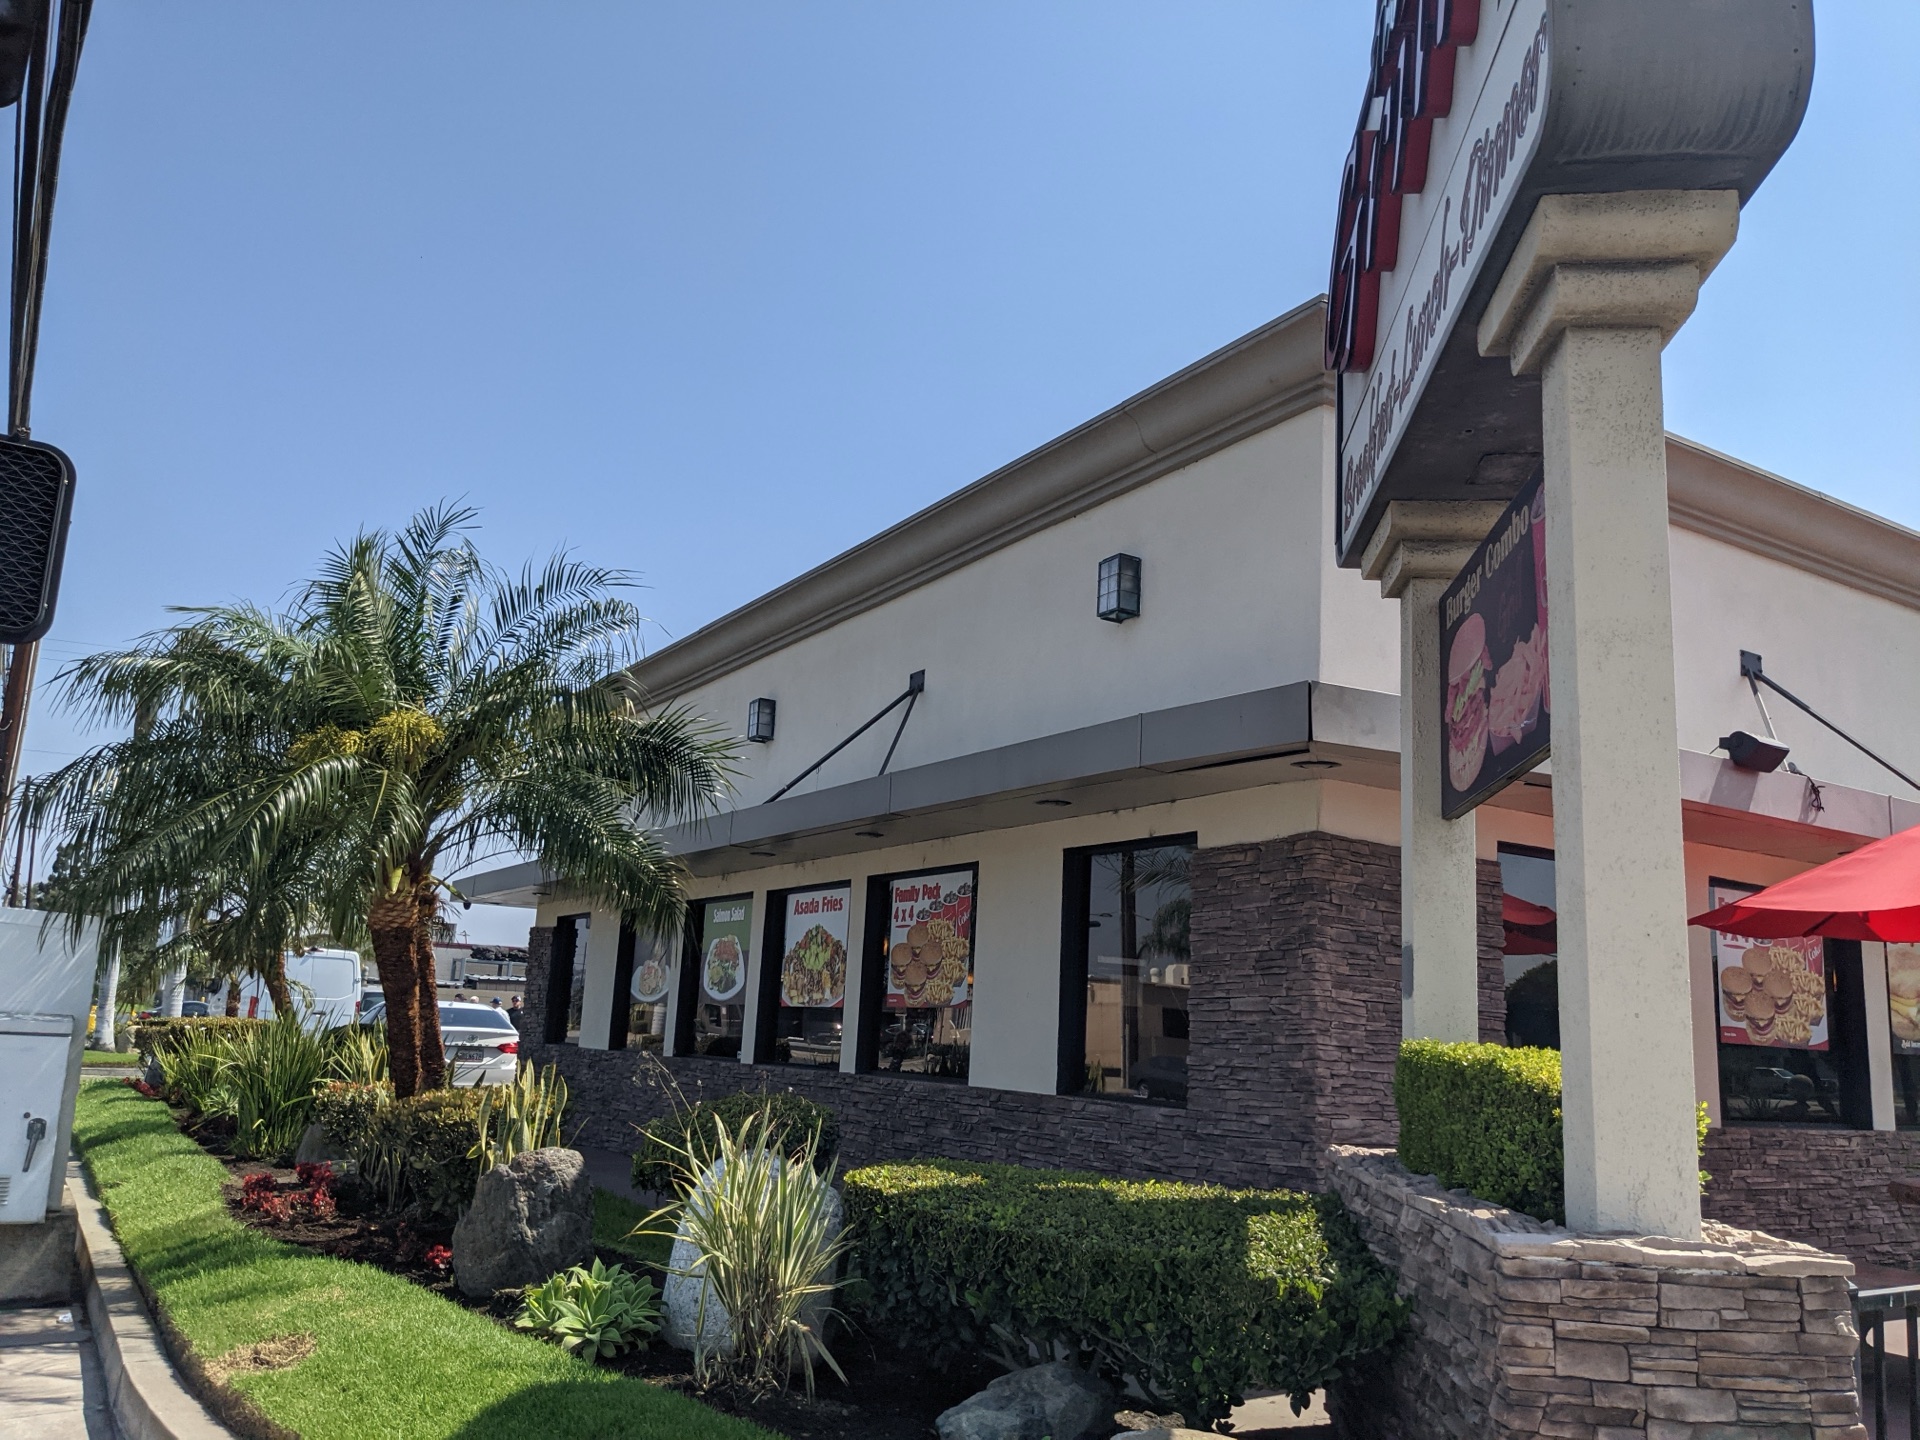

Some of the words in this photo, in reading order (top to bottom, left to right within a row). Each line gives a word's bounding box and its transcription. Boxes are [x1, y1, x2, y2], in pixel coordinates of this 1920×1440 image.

[1446, 565, 1482, 630] Burger
[1485, 505, 1529, 579] Combo
[895, 885, 920, 903] Family
[922, 882, 941, 900] Pack
[794, 897, 819, 915] Asada
[821, 895, 843, 912] Fries
[894, 906, 899, 922] 4
[908, 905, 914, 922] 4
